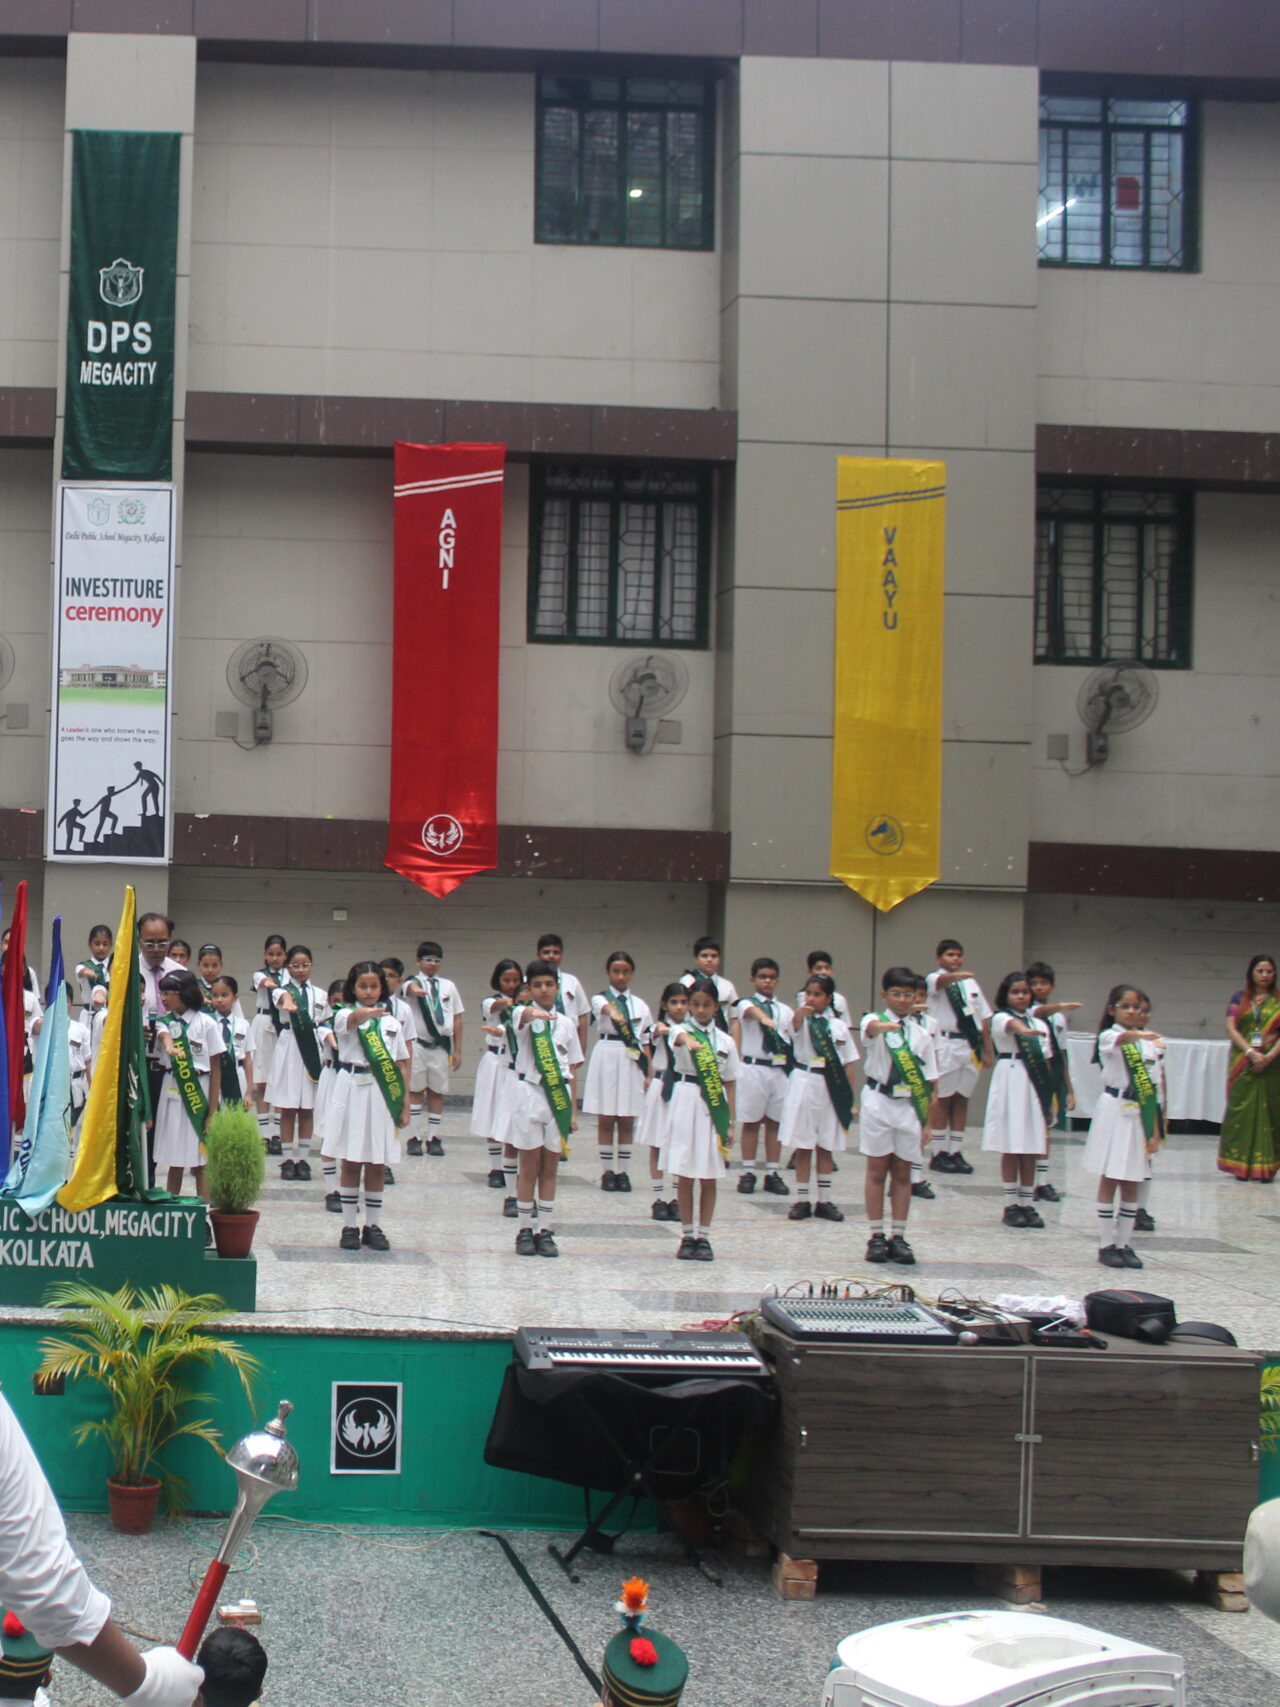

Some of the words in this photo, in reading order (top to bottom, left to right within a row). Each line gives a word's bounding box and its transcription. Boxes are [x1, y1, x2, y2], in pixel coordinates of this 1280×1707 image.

[87, 320, 152, 354] DPS
[80, 360, 158, 386] MEGACITY
[438, 508, 456, 589] AGNI
[65, 577, 164, 599] INVESTITURE
[882, 527, 898, 630] VAAYU
[65, 605, 164, 628] ceremony
[366, 1032, 388, 1060] DEPUTY
[534, 1036, 551, 1059] HOUSE
[380, 1060, 397, 1082] HEAD
[542, 1059, 560, 1086] CAPTAIN
[896, 1050, 916, 1072] HOUSE
[173, 1041, 191, 1079] HAD
[184, 1082, 204, 1114] GIRL
[708, 1062, 722, 1094] HOUSE
[1135, 1062, 1154, 1097] HOUSE
[388, 1082, 402, 1101] GIRL
[704, 1076, 720, 1107] VAAYU
